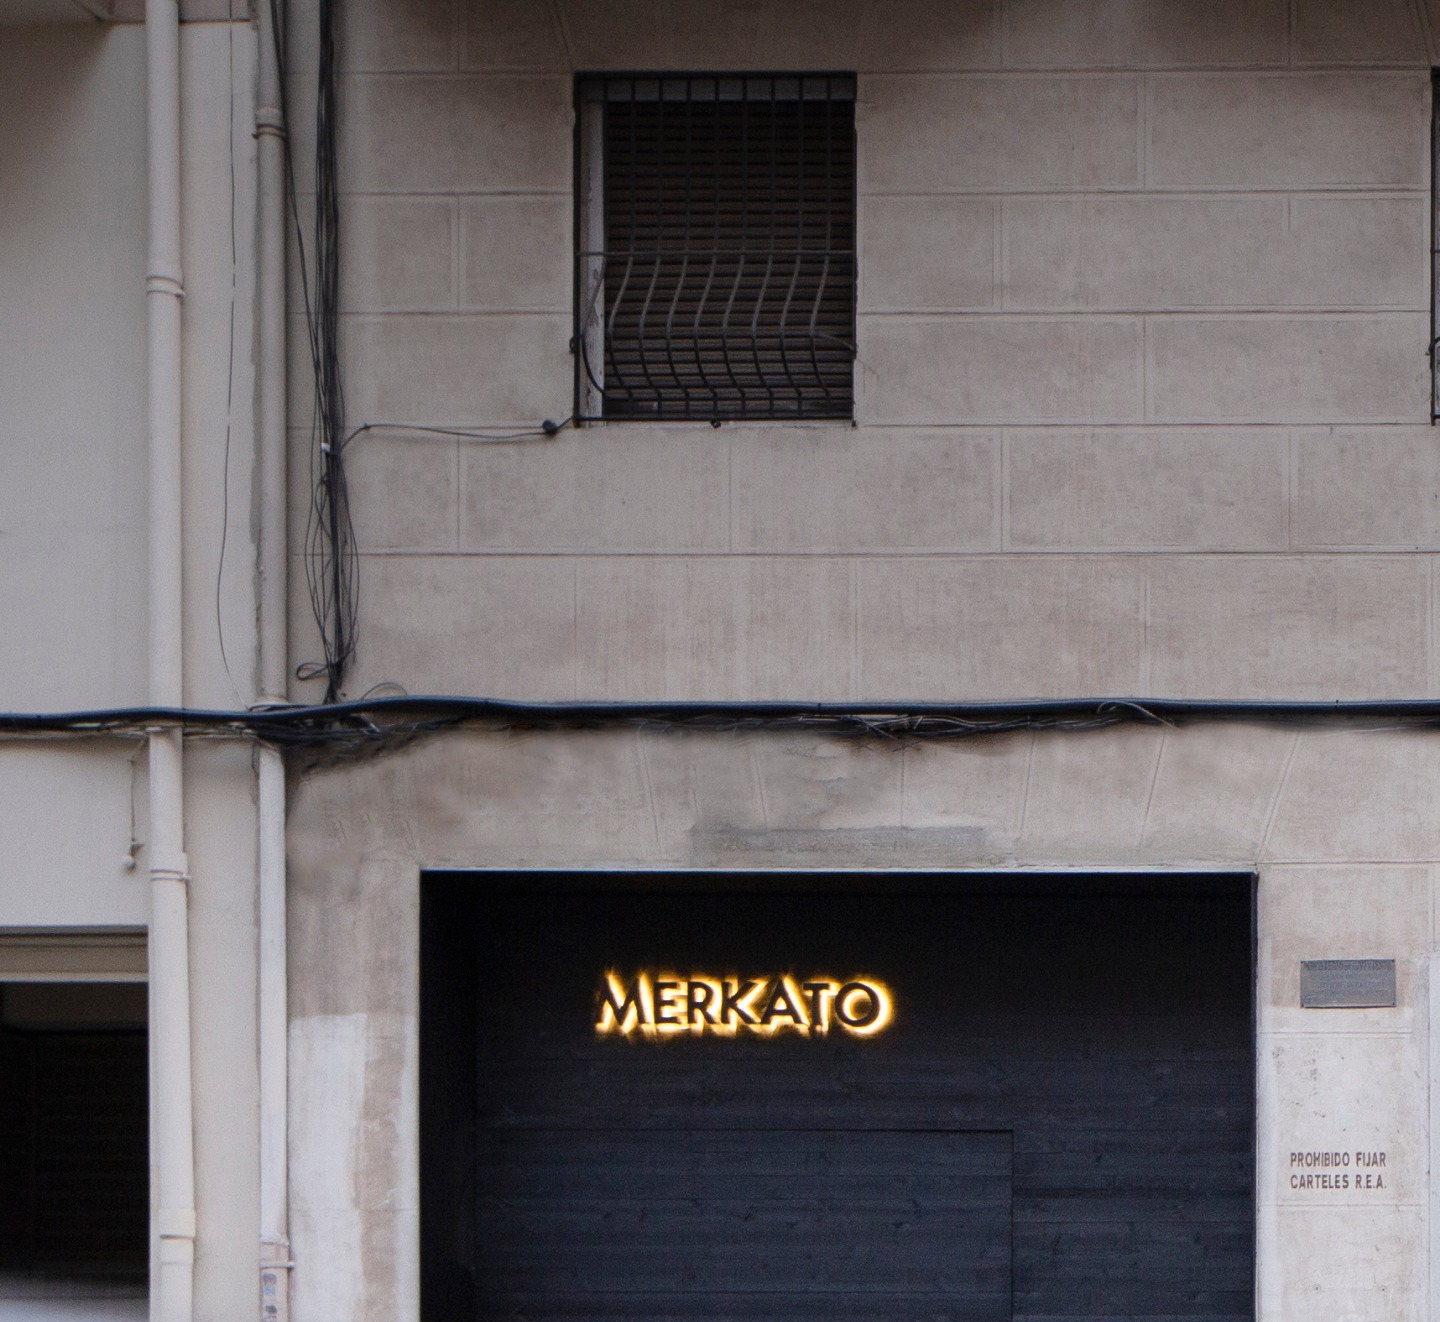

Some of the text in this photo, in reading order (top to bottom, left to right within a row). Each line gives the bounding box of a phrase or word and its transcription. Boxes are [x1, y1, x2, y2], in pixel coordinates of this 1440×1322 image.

[599, 974, 885, 1031] MERKATO
[1290, 1151, 1386, 1167] PROHIBIDO FIJAR
[1290, 1174, 1387, 1189] CARTELES R.E.A.
